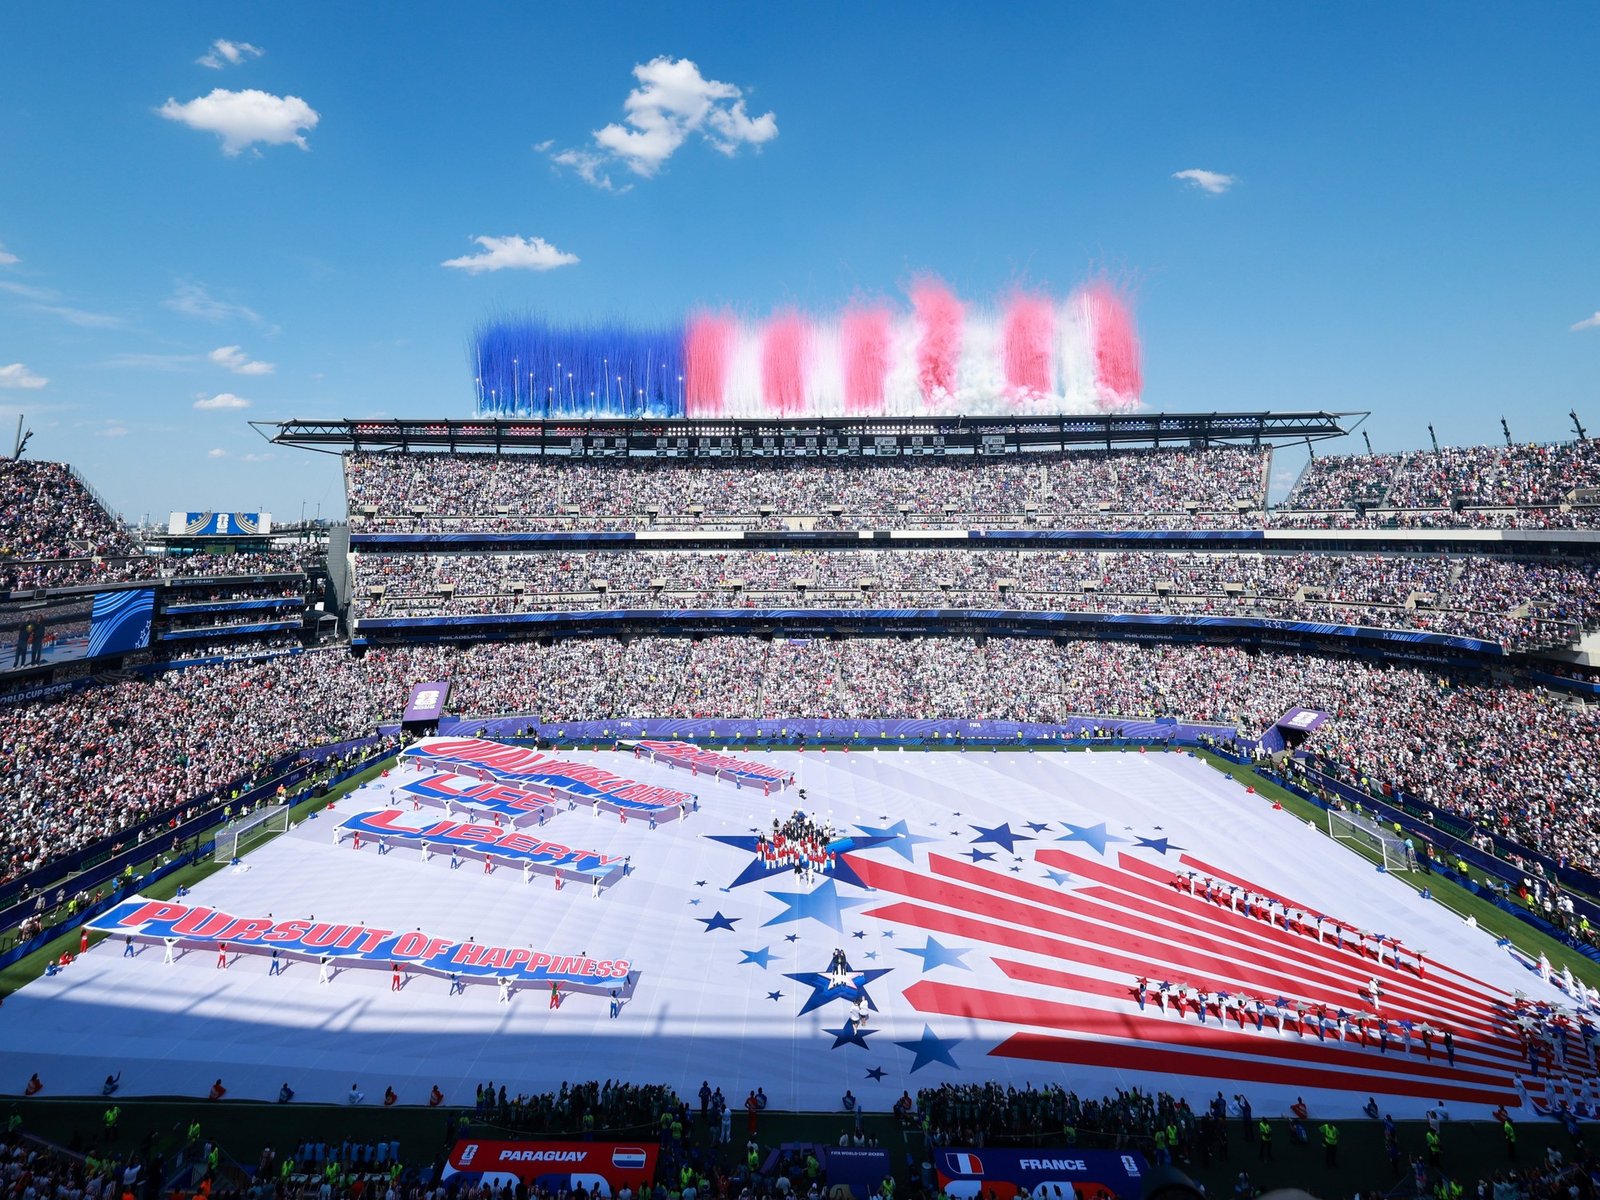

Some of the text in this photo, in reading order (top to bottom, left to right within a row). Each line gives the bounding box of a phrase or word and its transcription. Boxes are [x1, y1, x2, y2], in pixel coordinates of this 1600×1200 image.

[223, 648, 291, 661] PHILADELPHIA
[1384, 651, 1449, 664] PHILADELPHIA
[0, 682, 72, 705] ORLD CUP 2026
[420, 774, 556, 811] LIFE
[614, 784, 693, 806] RIGHTS
[357, 809, 624, 866] LIBERTY
[119, 900, 631, 979] PURSUIT OF HAPPINESS
[498, 1150, 588, 1162] PARAGUAY
[1020, 1159, 1087, 1170] FRANCE
